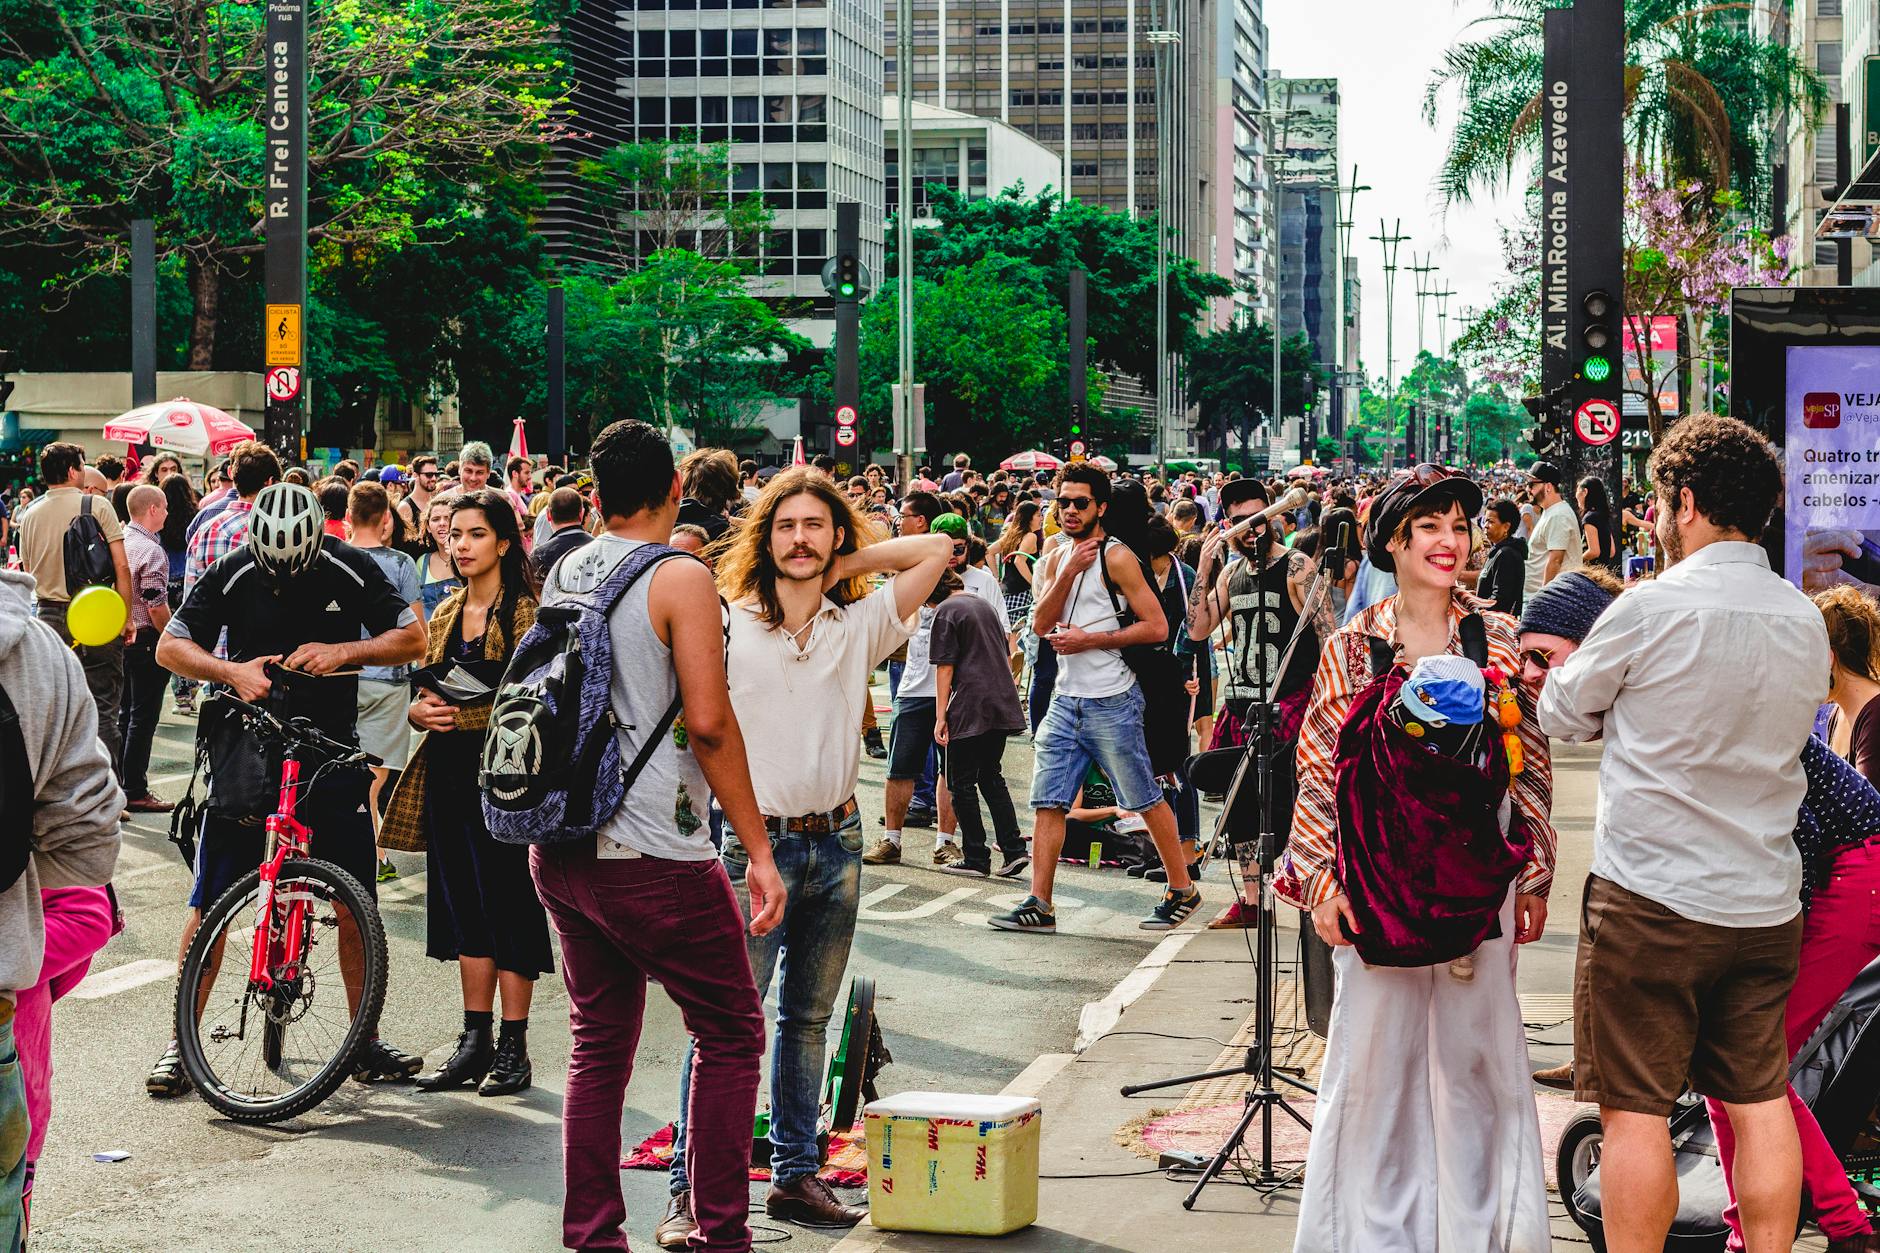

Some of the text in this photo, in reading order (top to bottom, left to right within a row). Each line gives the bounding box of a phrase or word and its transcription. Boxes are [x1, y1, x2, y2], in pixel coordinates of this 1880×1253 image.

[269, 3, 301, 12] Próxima
[270, 41, 289, 218] R. Frei Caneca
[1548, 80, 1568, 183] Azevedo
[1867, 131, 1880, 145] B
[1547, 319, 1567, 350] Al.
[1804, 449, 1861, 463] Quatro
[1804, 470, 1880, 485] amenizar
[1804, 492, 1867, 507] cabelos
[928, 1119, 939, 1151] AM
